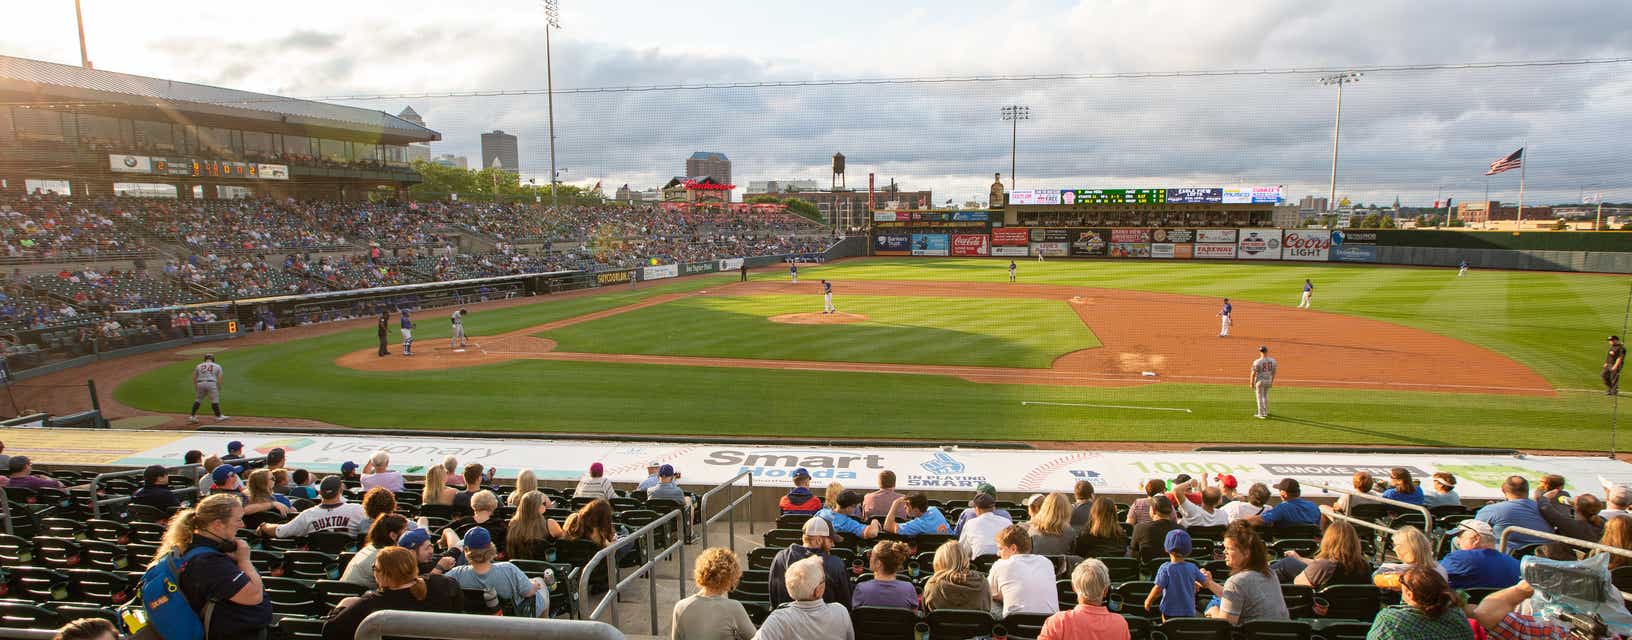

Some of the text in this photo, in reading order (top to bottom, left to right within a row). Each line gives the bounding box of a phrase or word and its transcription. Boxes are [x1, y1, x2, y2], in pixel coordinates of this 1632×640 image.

[1283, 232, 1330, 250] Coors
[1290, 249, 1321, 257] LIGHT
[200, 364, 214, 375] 24
[703, 450, 885, 470] Smart
[737, 467, 857, 479] Hoda
[1271, 465, 1350, 476] SMOKE
[312, 515, 351, 531] BUXTON
